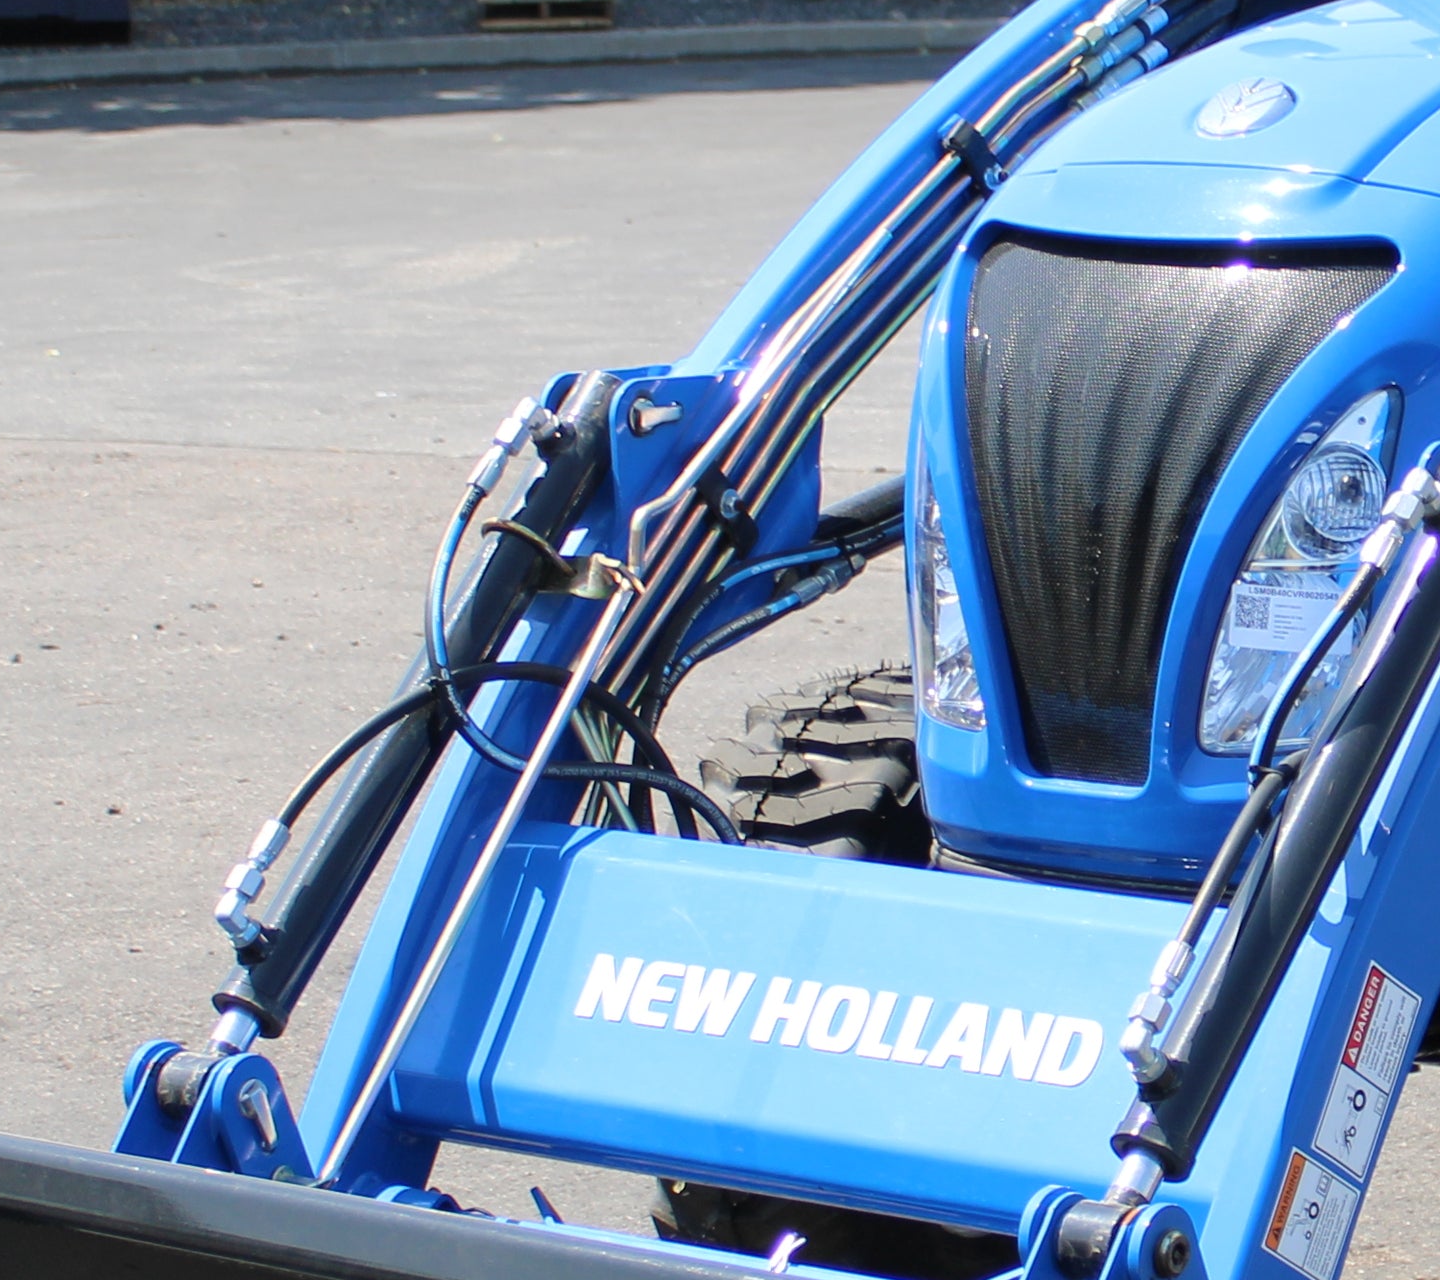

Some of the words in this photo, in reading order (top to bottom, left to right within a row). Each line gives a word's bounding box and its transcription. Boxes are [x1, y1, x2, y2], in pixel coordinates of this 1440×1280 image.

[573, 952, 756, 1038] NEW
[749, 976, 1105, 1088] HOLLAND
[1354, 976, 1380, 1042] DANGER
[1277, 1165, 1301, 1224] WARNING
